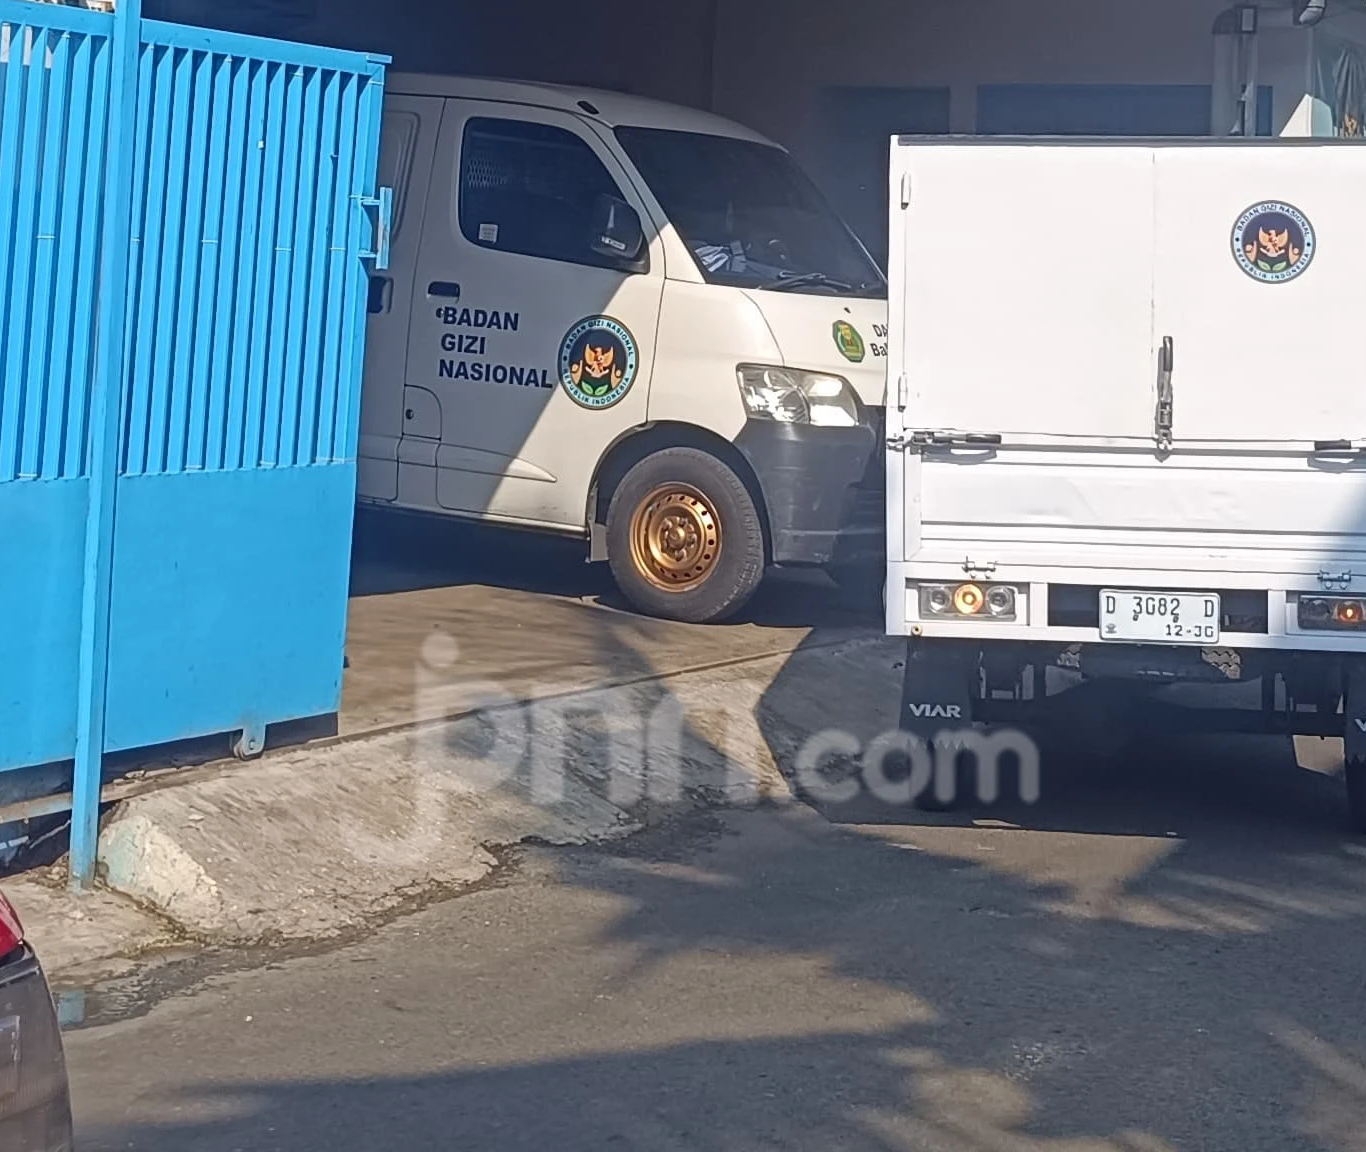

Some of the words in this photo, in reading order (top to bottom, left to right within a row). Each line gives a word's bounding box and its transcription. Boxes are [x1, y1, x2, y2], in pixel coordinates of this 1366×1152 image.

[443, 306, 519, 331] BADAN
[441, 333, 486, 355] GIZI
[438, 359, 553, 389] NASIONAL
[1105, 595, 1116, 615] D
[1203, 599, 1215, 618] D
[908, 703, 962, 718] VIAR
